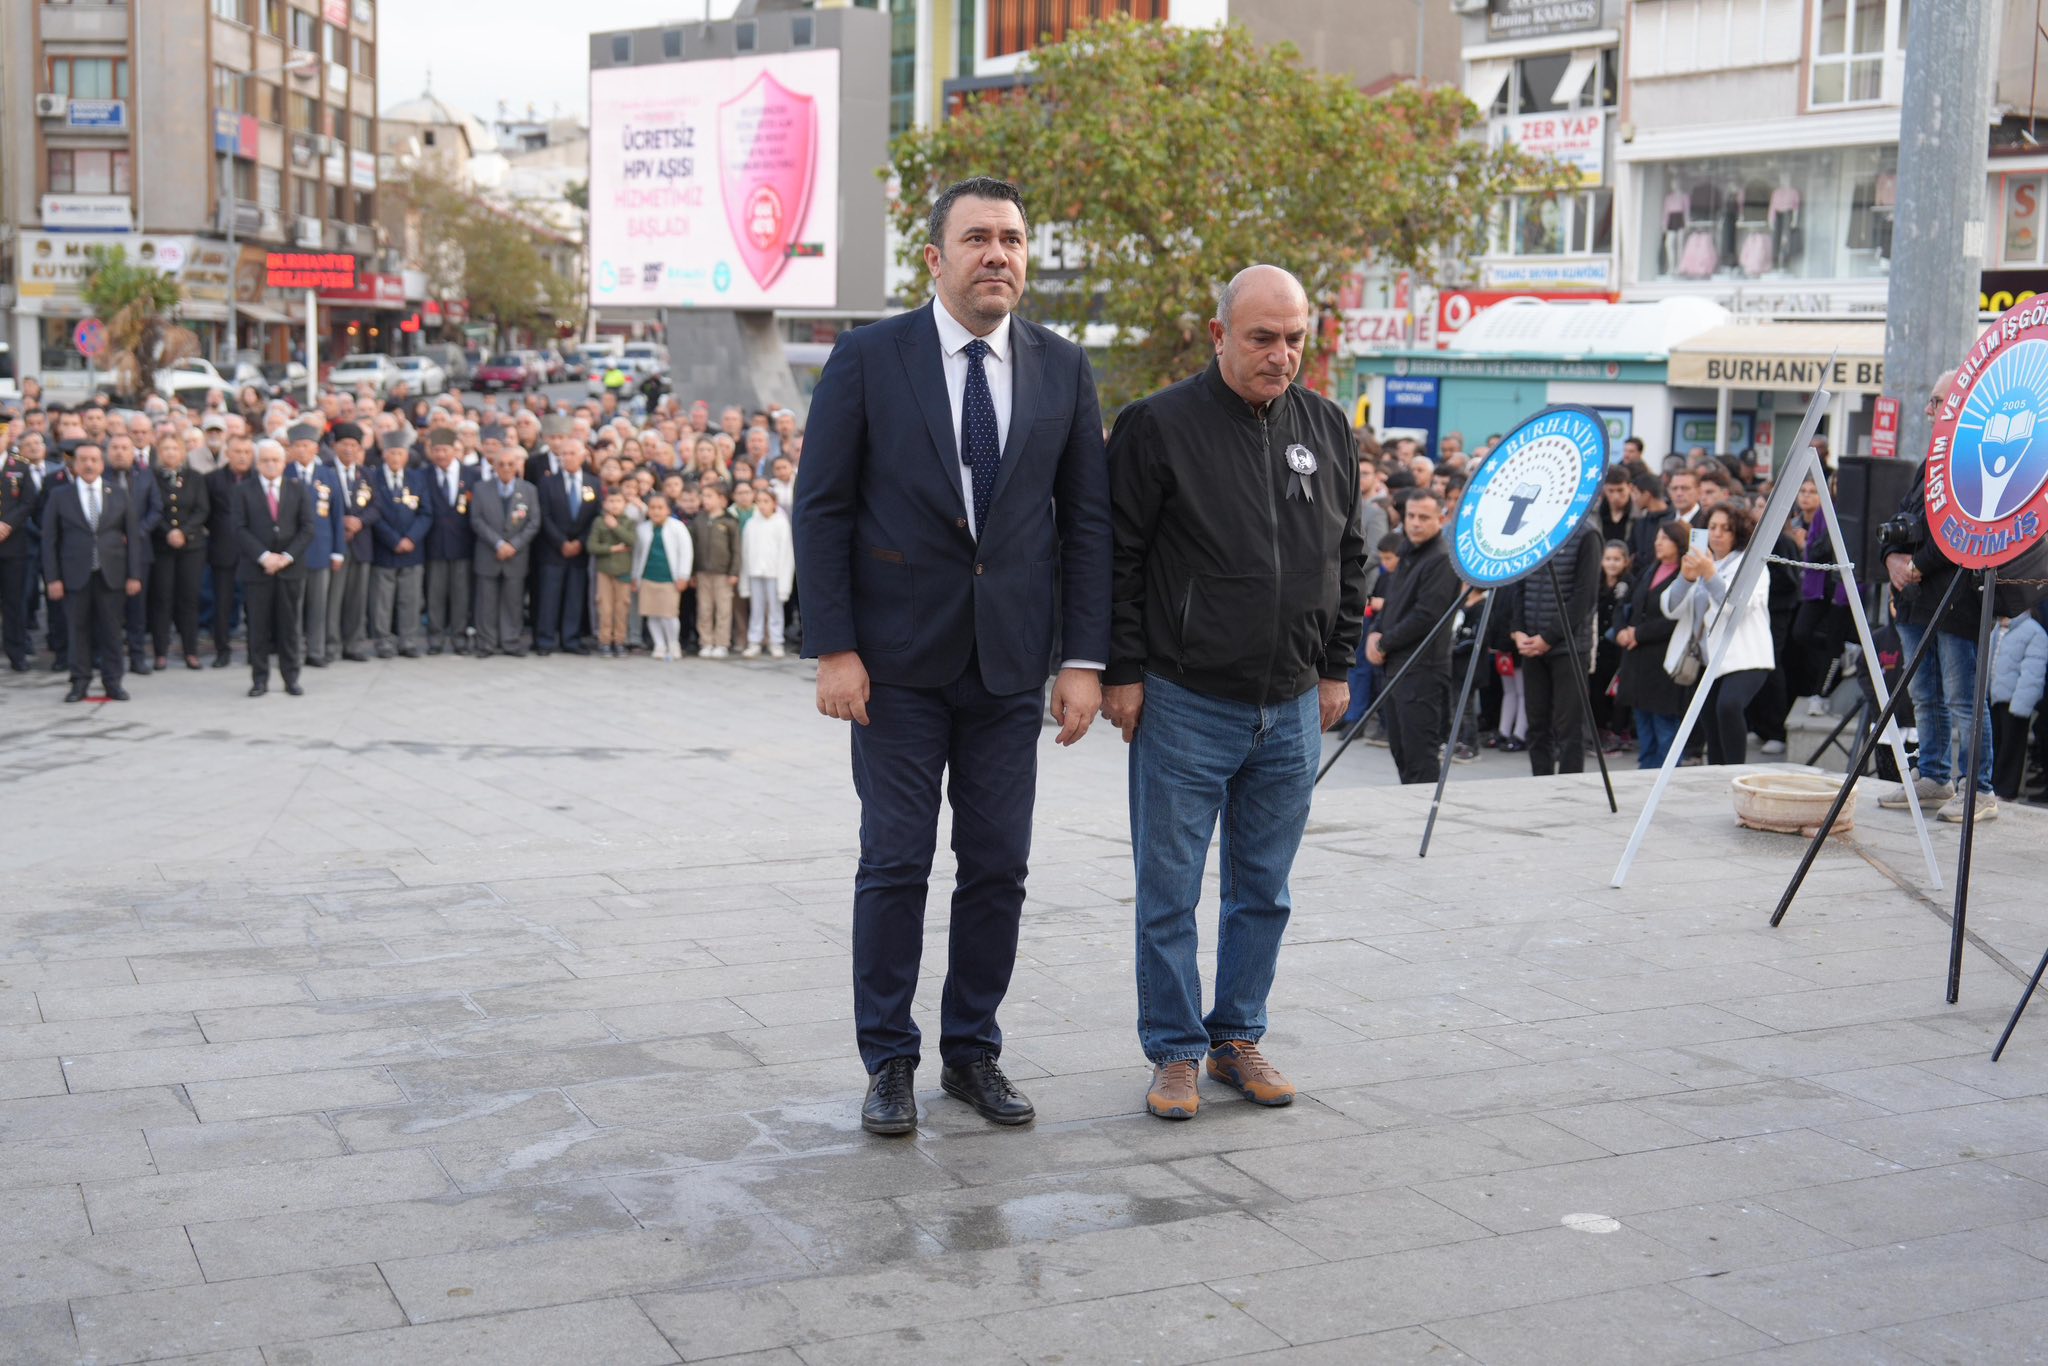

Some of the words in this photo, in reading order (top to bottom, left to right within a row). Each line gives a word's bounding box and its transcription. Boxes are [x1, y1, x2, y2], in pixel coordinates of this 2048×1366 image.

[622, 124, 695, 151] ÜCRETSİZ
[1521, 120, 1556, 141] ZER
[1562, 116, 1598, 136] YAP
[624, 159, 654, 179] HPV
[657, 157, 694, 185] AŞISI
[1940, 392, 1963, 422] VE
[2002, 399, 2026, 411] 2005
[1940, 511, 2039, 556] EĞİTİM-İŞ
[1457, 528, 1481, 570] KENT
